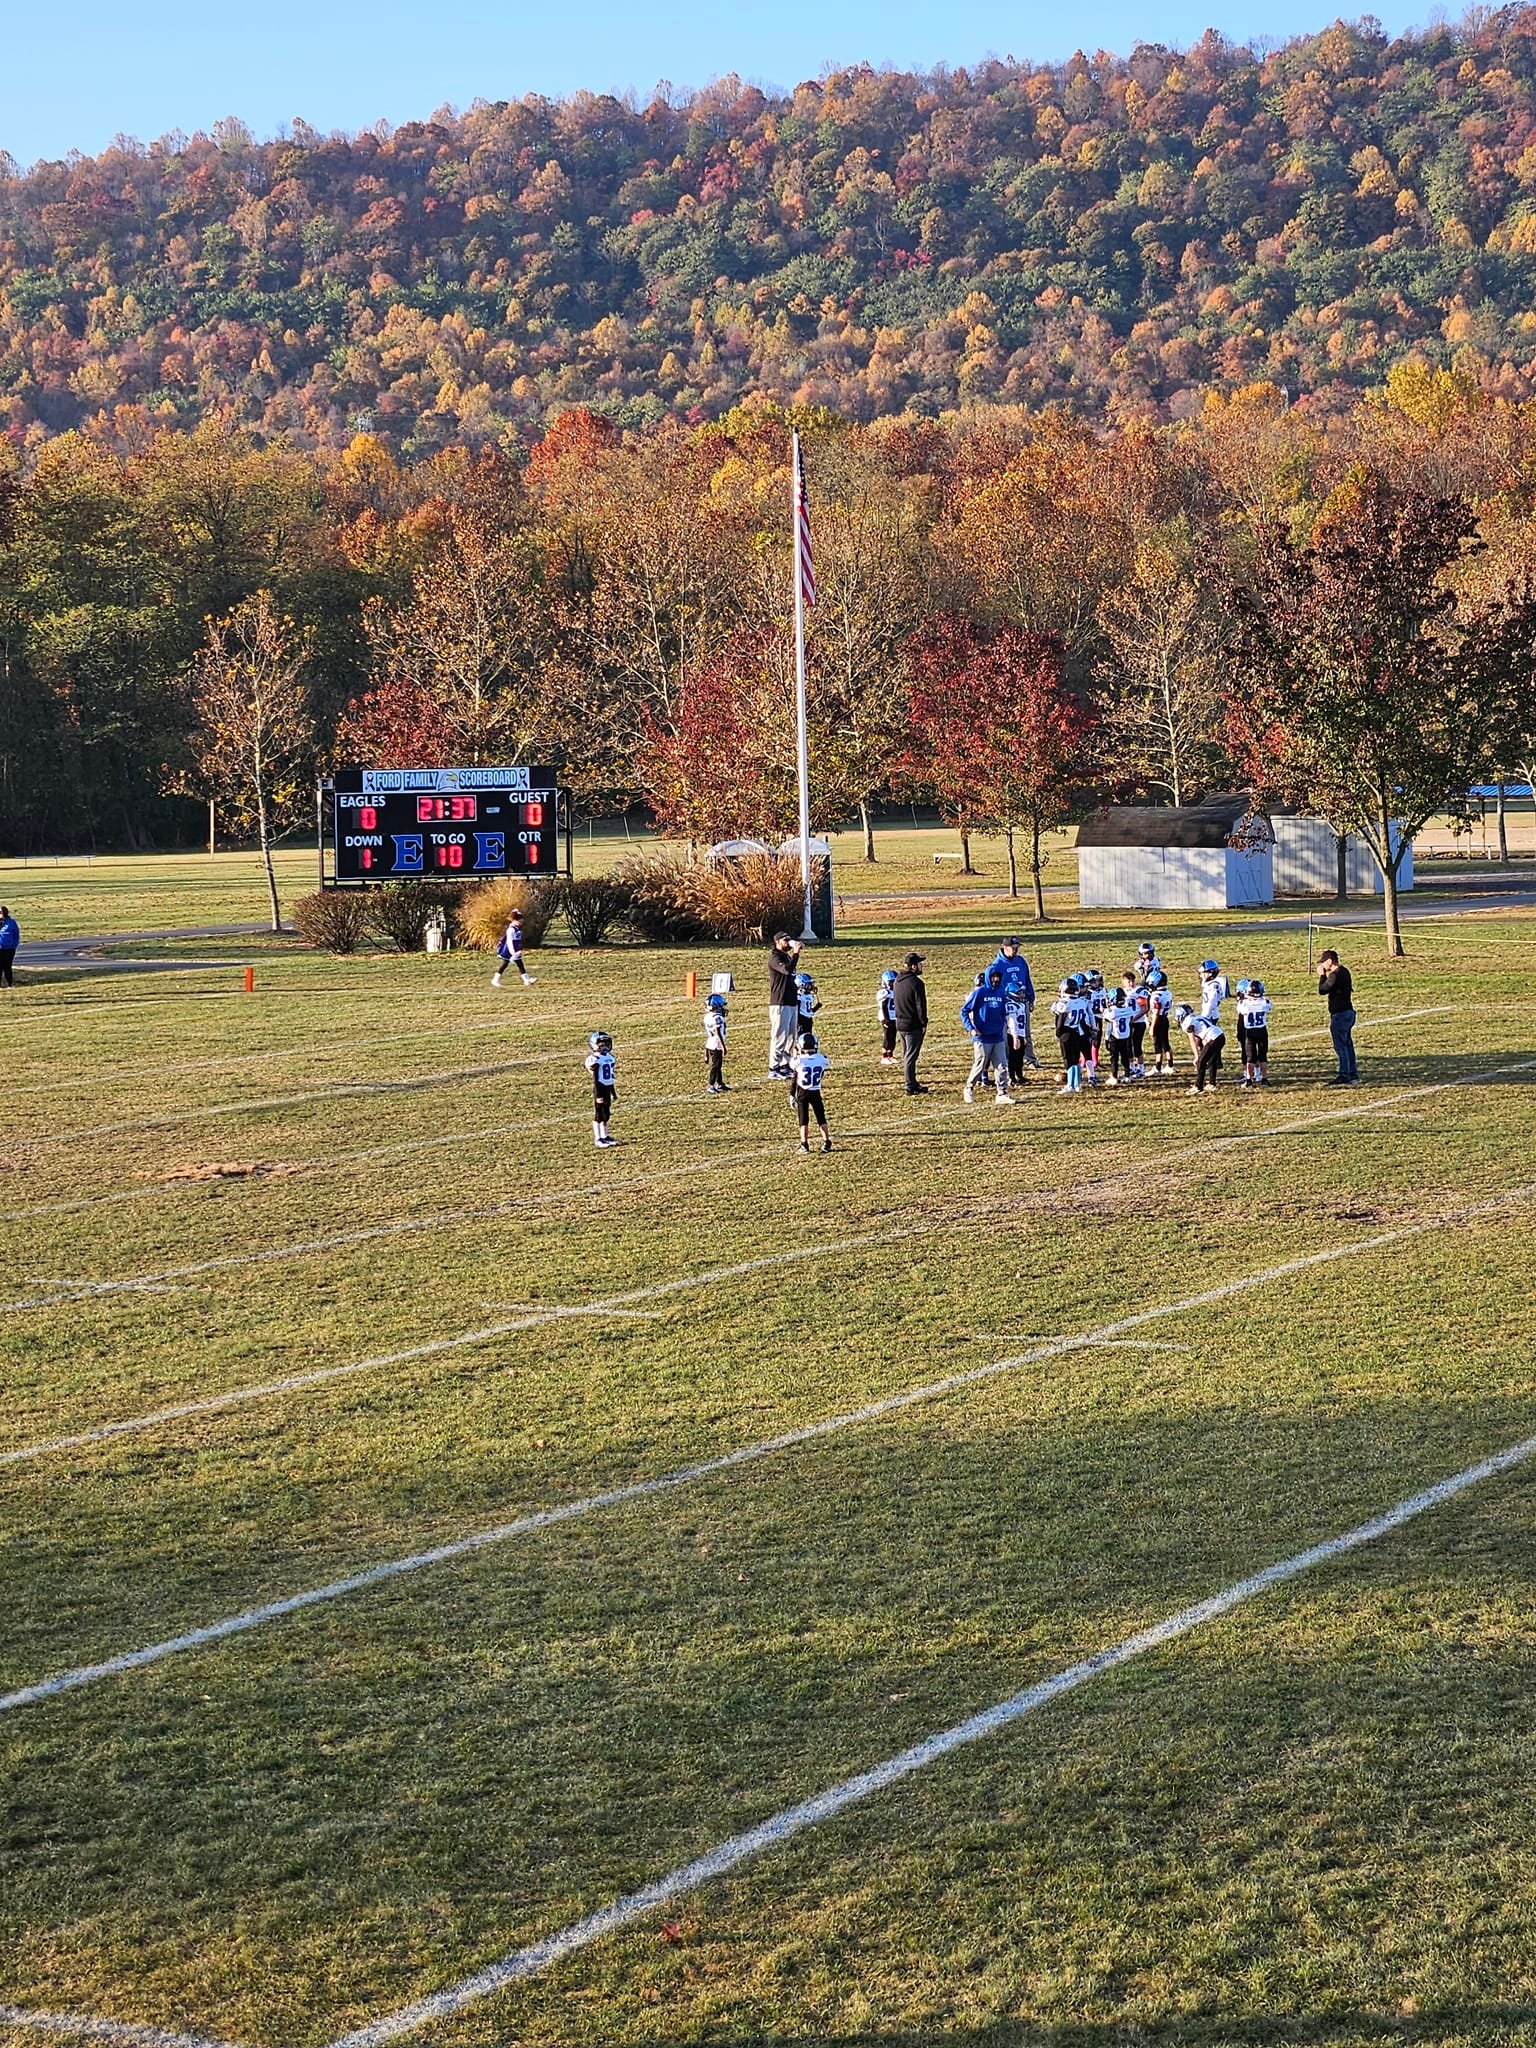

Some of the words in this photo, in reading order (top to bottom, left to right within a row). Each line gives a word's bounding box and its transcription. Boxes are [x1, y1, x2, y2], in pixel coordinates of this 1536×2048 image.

[376, 772, 401, 789] FORD
[404, 771, 438, 788] FAMILY
[459, 769, 517, 788] SCOREBOARD
[340, 795, 386, 808] EAGLES
[509, 791, 549, 804] GUEST
[361, 807, 377, 830] 0
[419, 797, 475, 820] 21:37
[527, 803, 543, 826] 0
[345, 835, 382, 847] DOWN
[430, 833, 446, 845] TO
[448, 833, 466, 844] GO
[518, 831, 542, 843] QTR
[438, 845, 463, 867] 10
[529, 844, 538, 865] 1
[802, 1065, 823, 1087] 32
